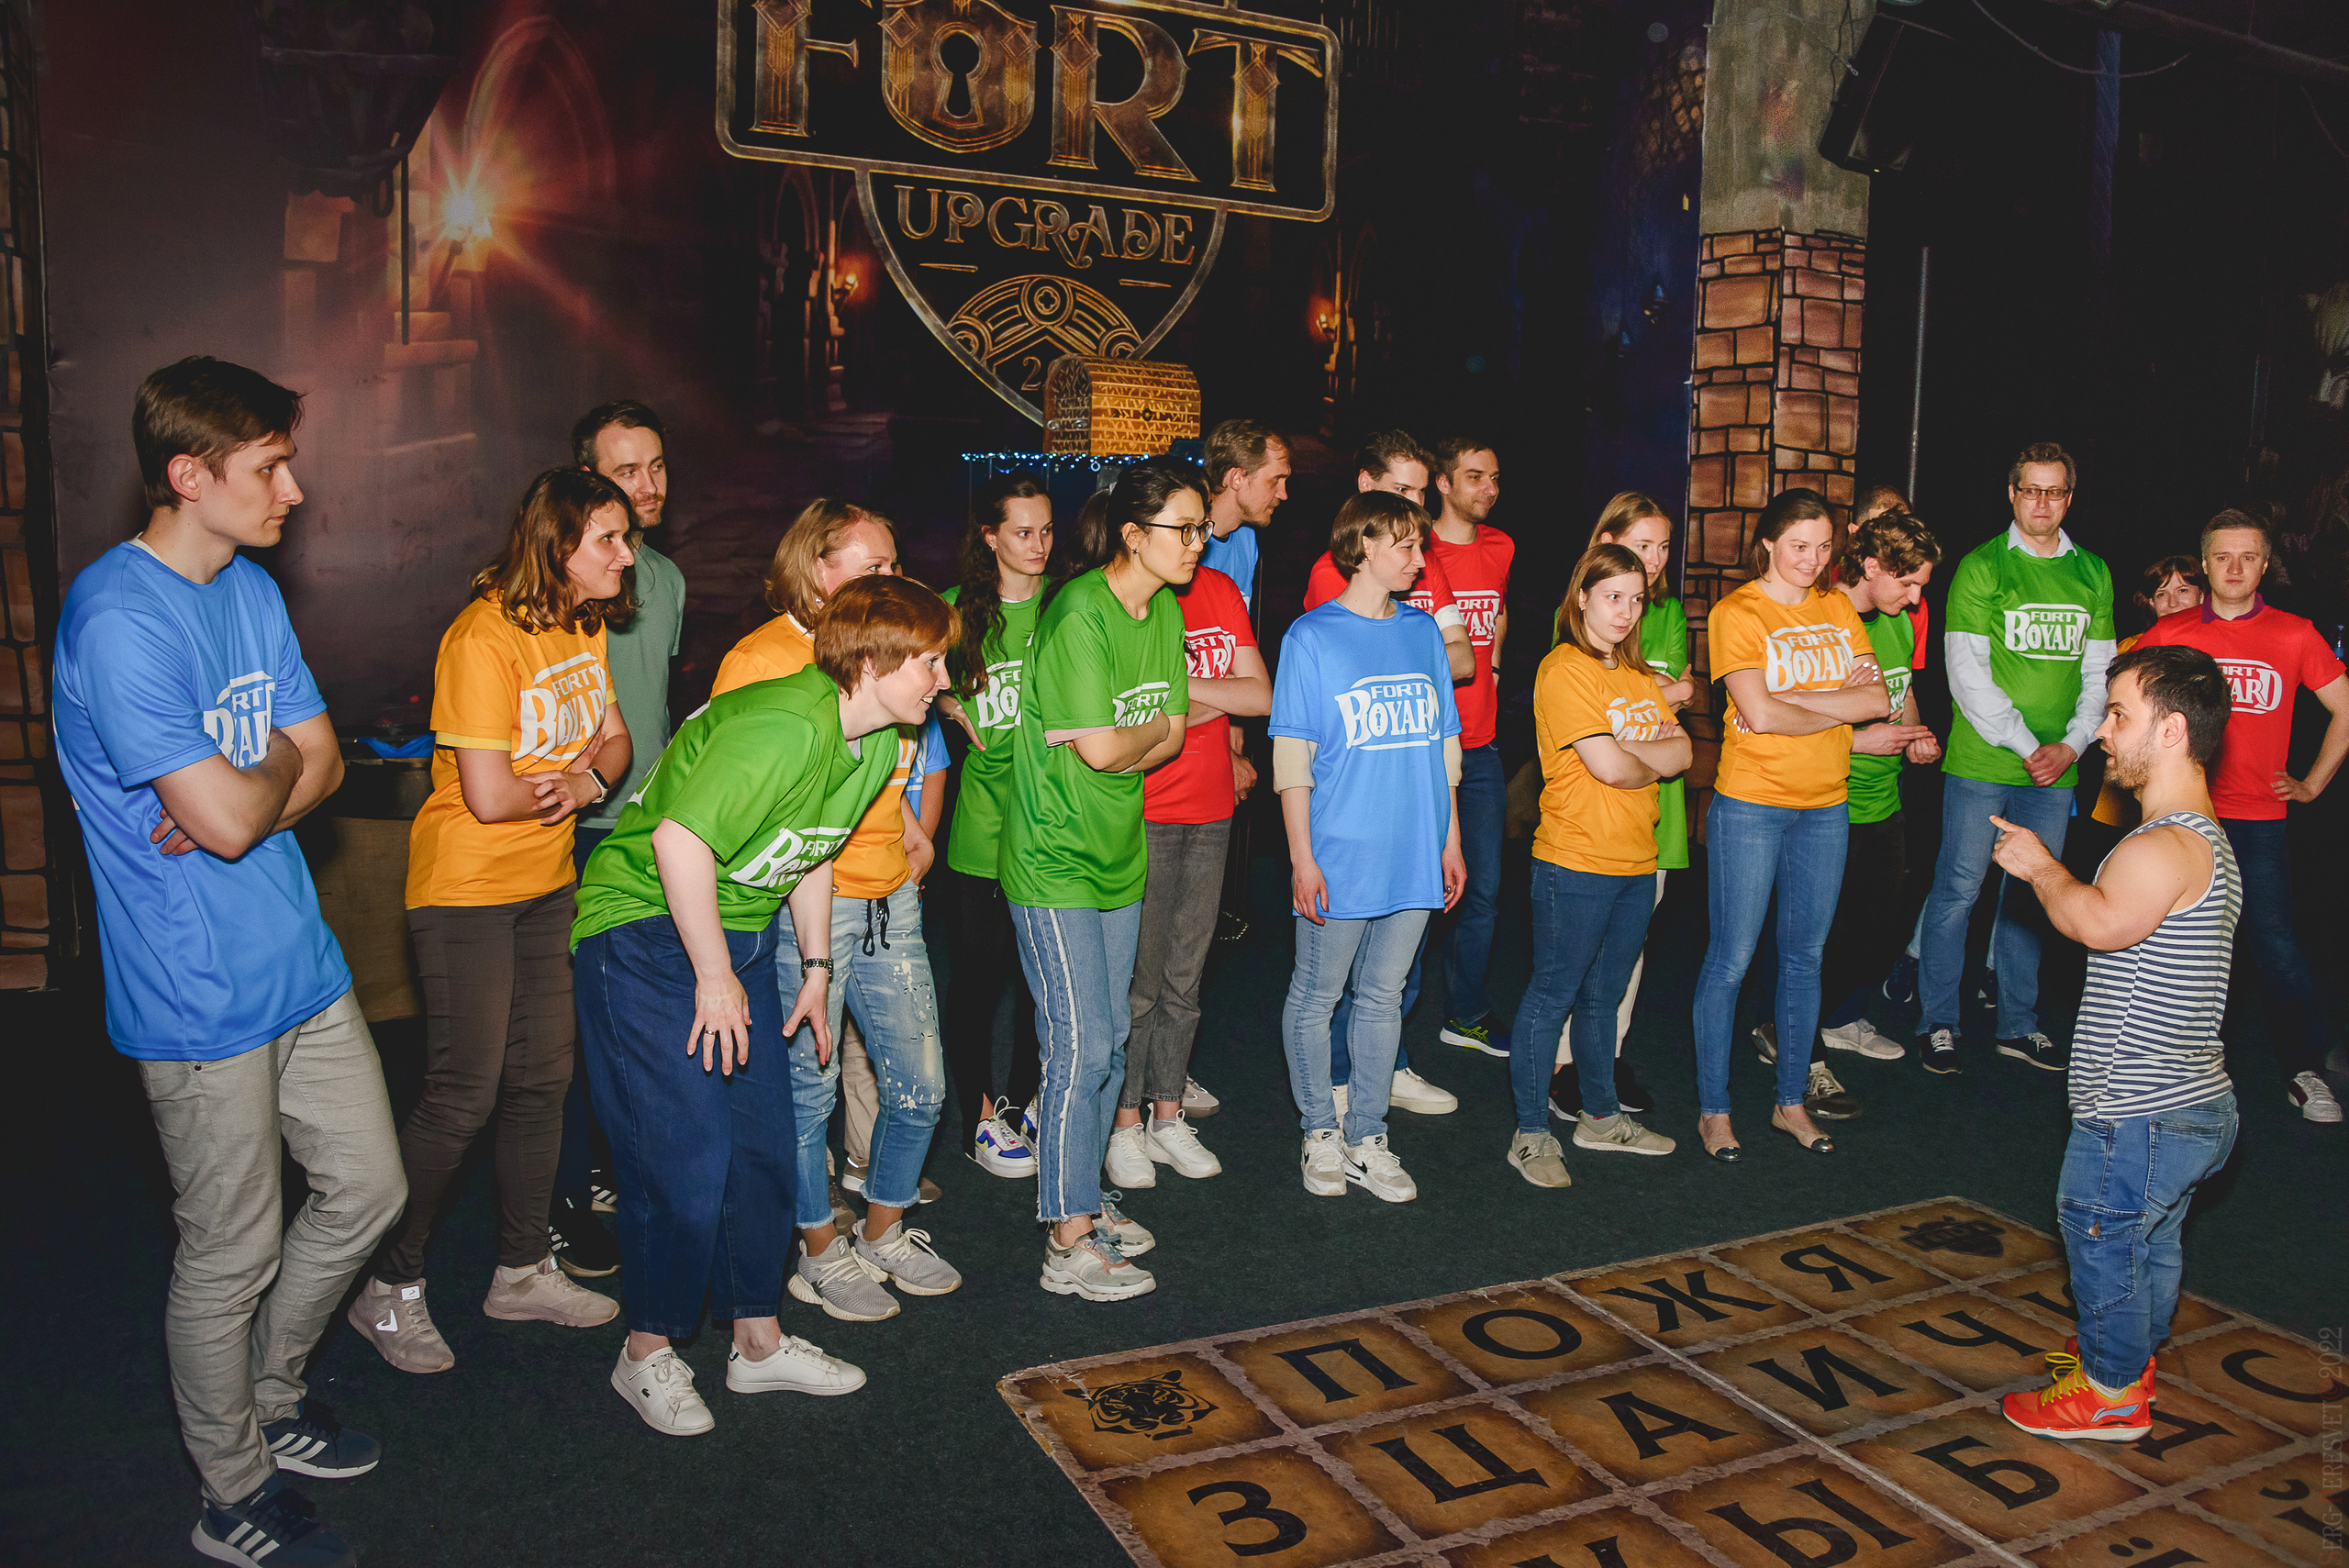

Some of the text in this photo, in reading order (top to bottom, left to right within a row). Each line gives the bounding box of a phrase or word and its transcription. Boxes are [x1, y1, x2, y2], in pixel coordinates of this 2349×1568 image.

[748, 0, 1323, 192] FORT
[894, 184, 1196, 269] UPGRADE
[1456, 598, 1492, 610] ORT
[2031, 611, 2074, 622] FORT
[1787, 631, 1836, 648] FORT
[2003, 610, 2091, 655] BOYARD
[551, 668, 590, 700] FORT
[1371, 683, 1424, 699] FORT
[231, 686, 264, 712] RT
[1334, 683, 1441, 750] BOYARD
